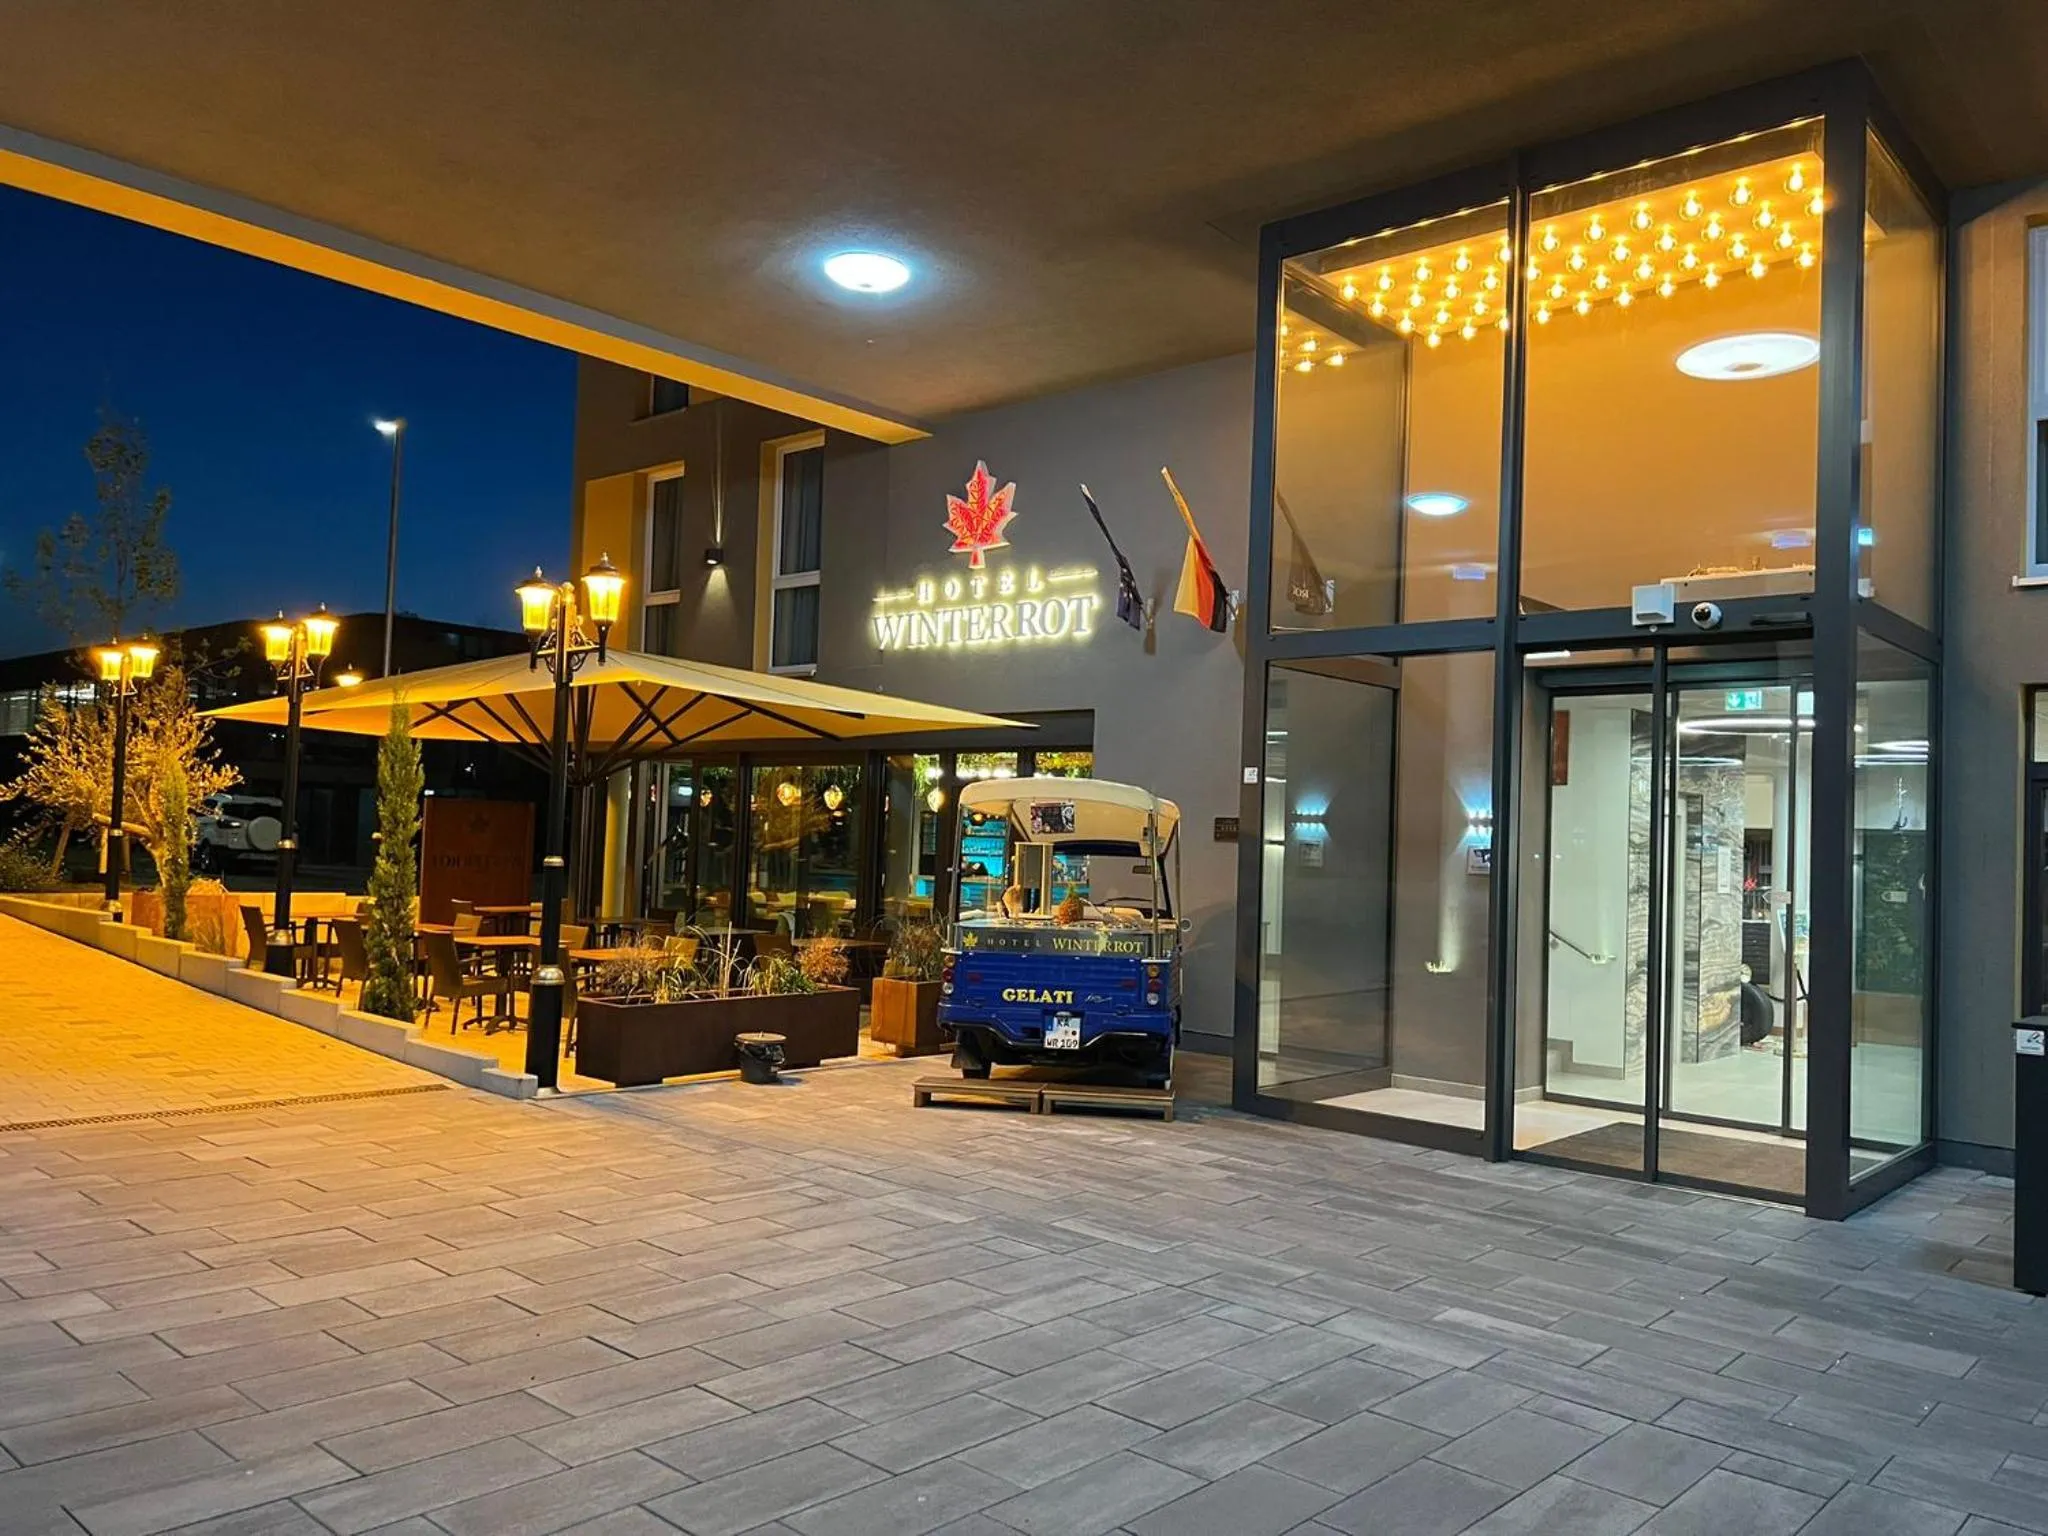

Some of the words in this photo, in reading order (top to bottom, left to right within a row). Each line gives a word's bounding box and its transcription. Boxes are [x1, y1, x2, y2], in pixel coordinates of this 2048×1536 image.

[917, 567, 1043, 603] HOTEL
[872, 594, 1097, 650] WINTERROT
[987, 938, 1041, 948] HOTEL
[1001, 988, 1074, 1004] GELATI
